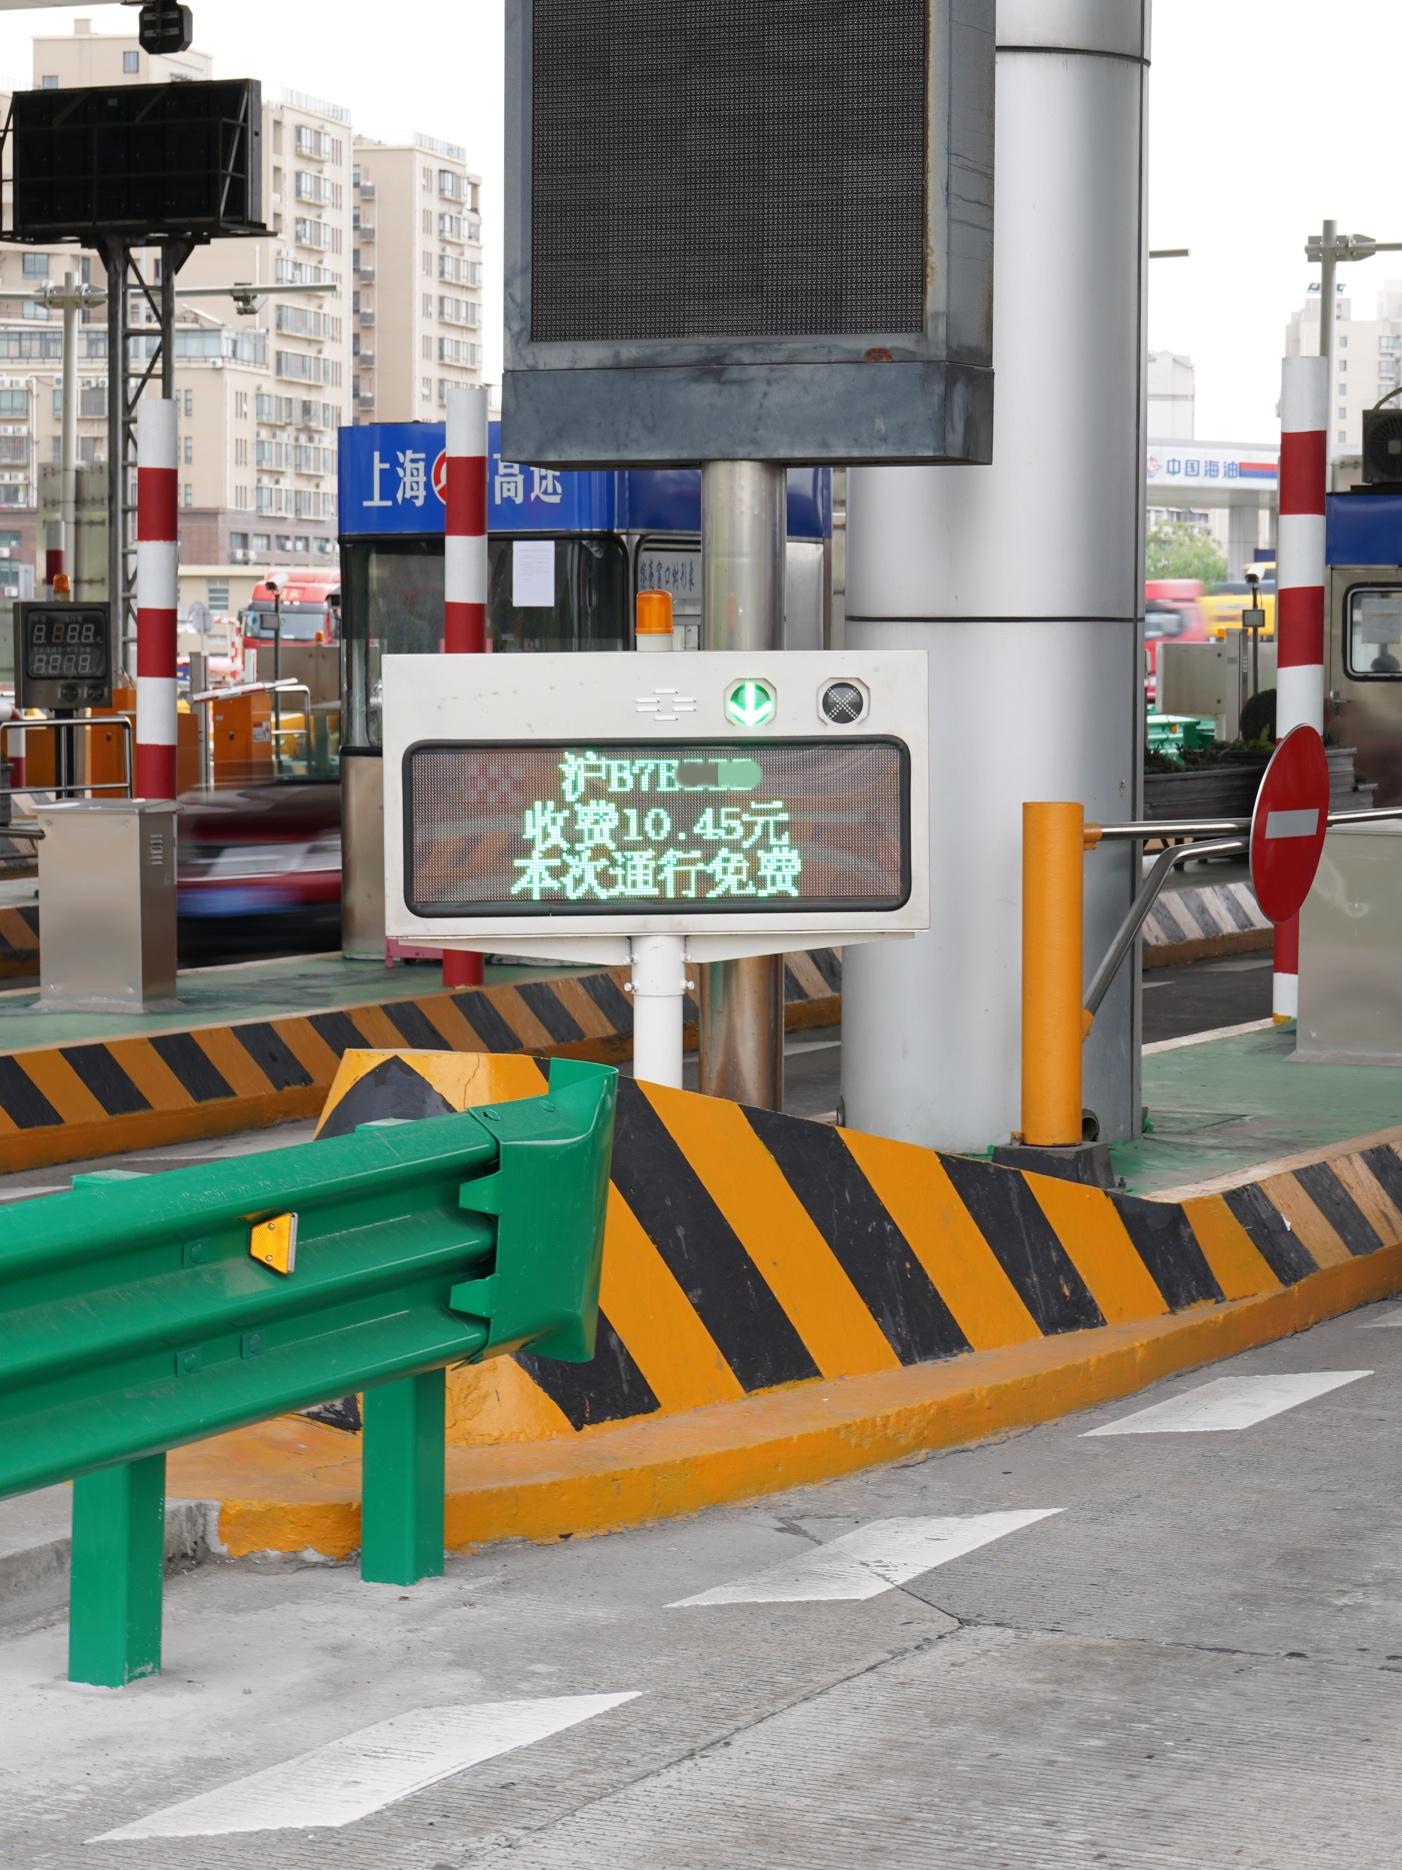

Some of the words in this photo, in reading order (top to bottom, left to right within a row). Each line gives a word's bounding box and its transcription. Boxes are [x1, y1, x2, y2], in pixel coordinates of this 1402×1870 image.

[362, 449, 427, 508] 上海
[1166, 457, 1238, 479] 中国海油
[524, 798, 790, 850] 收费10.45元
[510, 846, 802, 900] 本次通行免费
